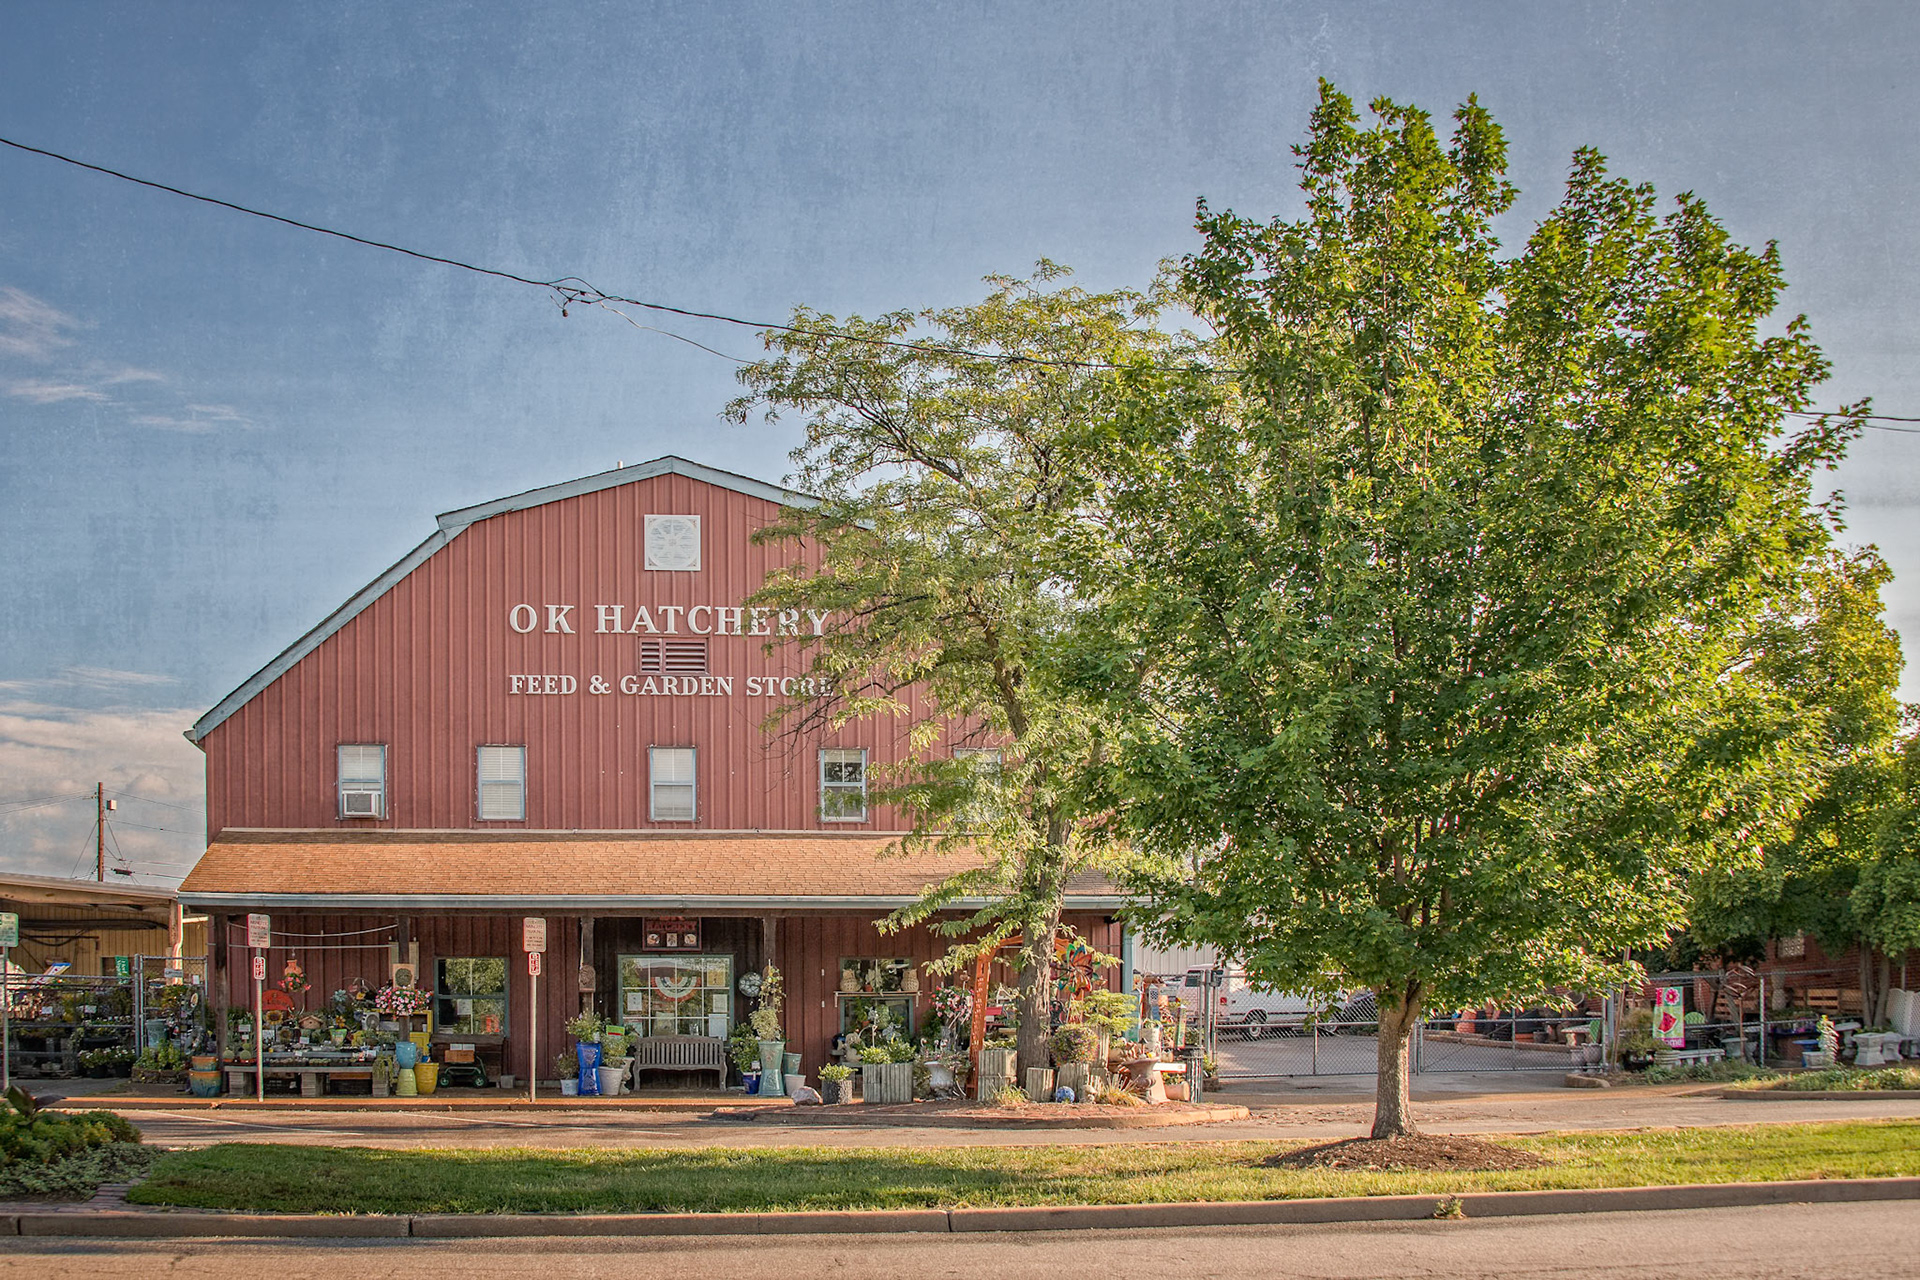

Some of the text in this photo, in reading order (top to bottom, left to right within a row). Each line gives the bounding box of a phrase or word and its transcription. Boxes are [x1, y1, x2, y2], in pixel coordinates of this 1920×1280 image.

[509, 603, 832, 636] OK HATCHERY
[509, 674, 834, 698] FEED & GARDEN STORE
